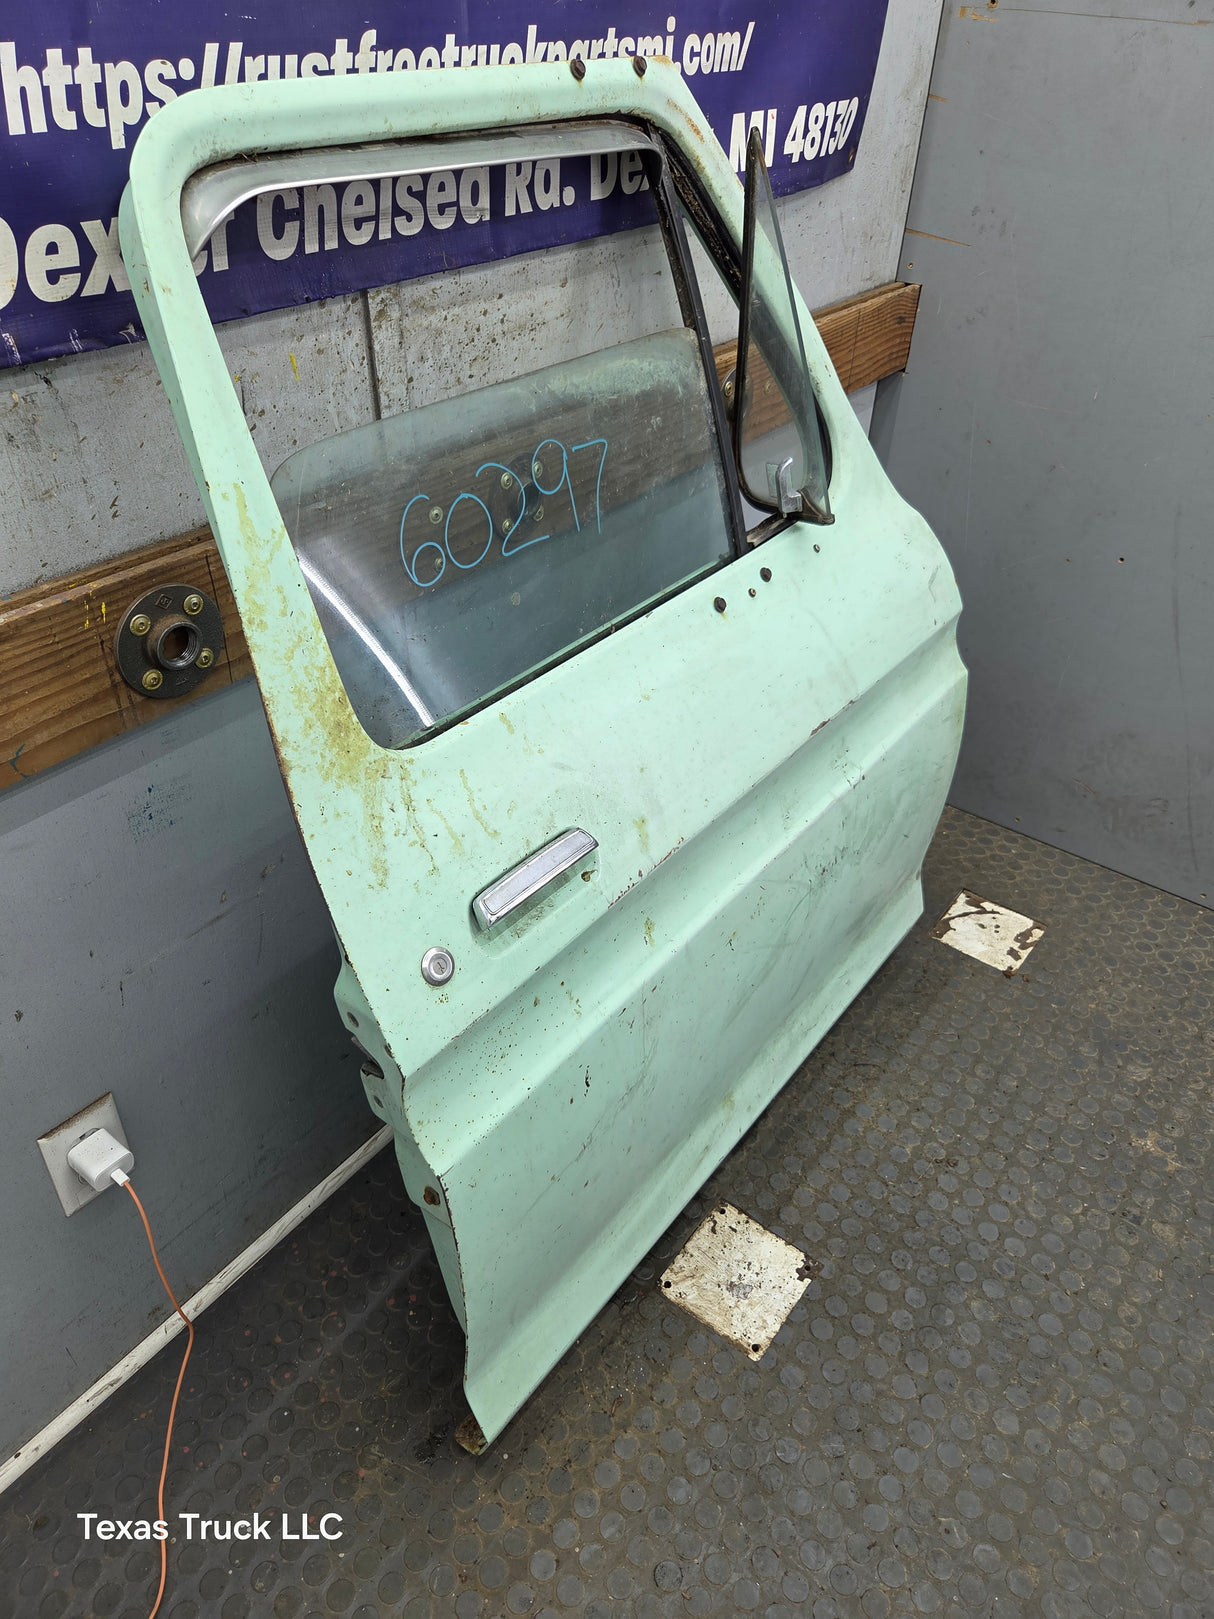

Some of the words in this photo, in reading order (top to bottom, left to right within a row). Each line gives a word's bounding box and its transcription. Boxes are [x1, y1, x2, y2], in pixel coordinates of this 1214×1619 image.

[729, 109, 777, 172] MI
[784, 96, 859, 164] 48130
[400, 438, 608, 587] 60297
